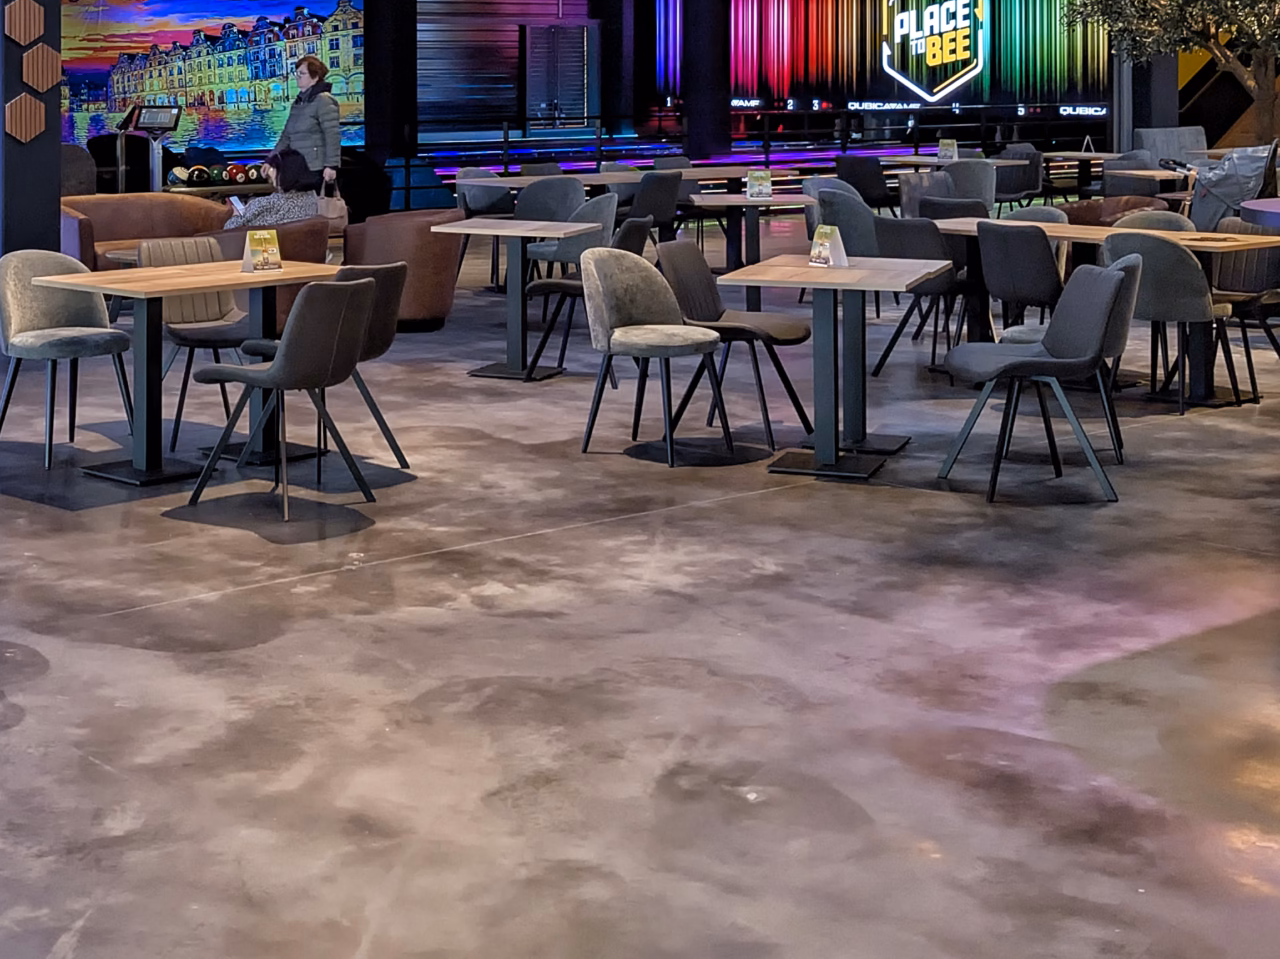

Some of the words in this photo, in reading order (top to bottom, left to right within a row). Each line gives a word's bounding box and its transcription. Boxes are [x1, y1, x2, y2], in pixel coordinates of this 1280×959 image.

[910, 37, 926, 56] TO
[926, 27, 971, 67] BEE
[666, 96, 671, 107] 1
[786, 99, 794, 110] 2
[812, 99, 819, 111] 3
